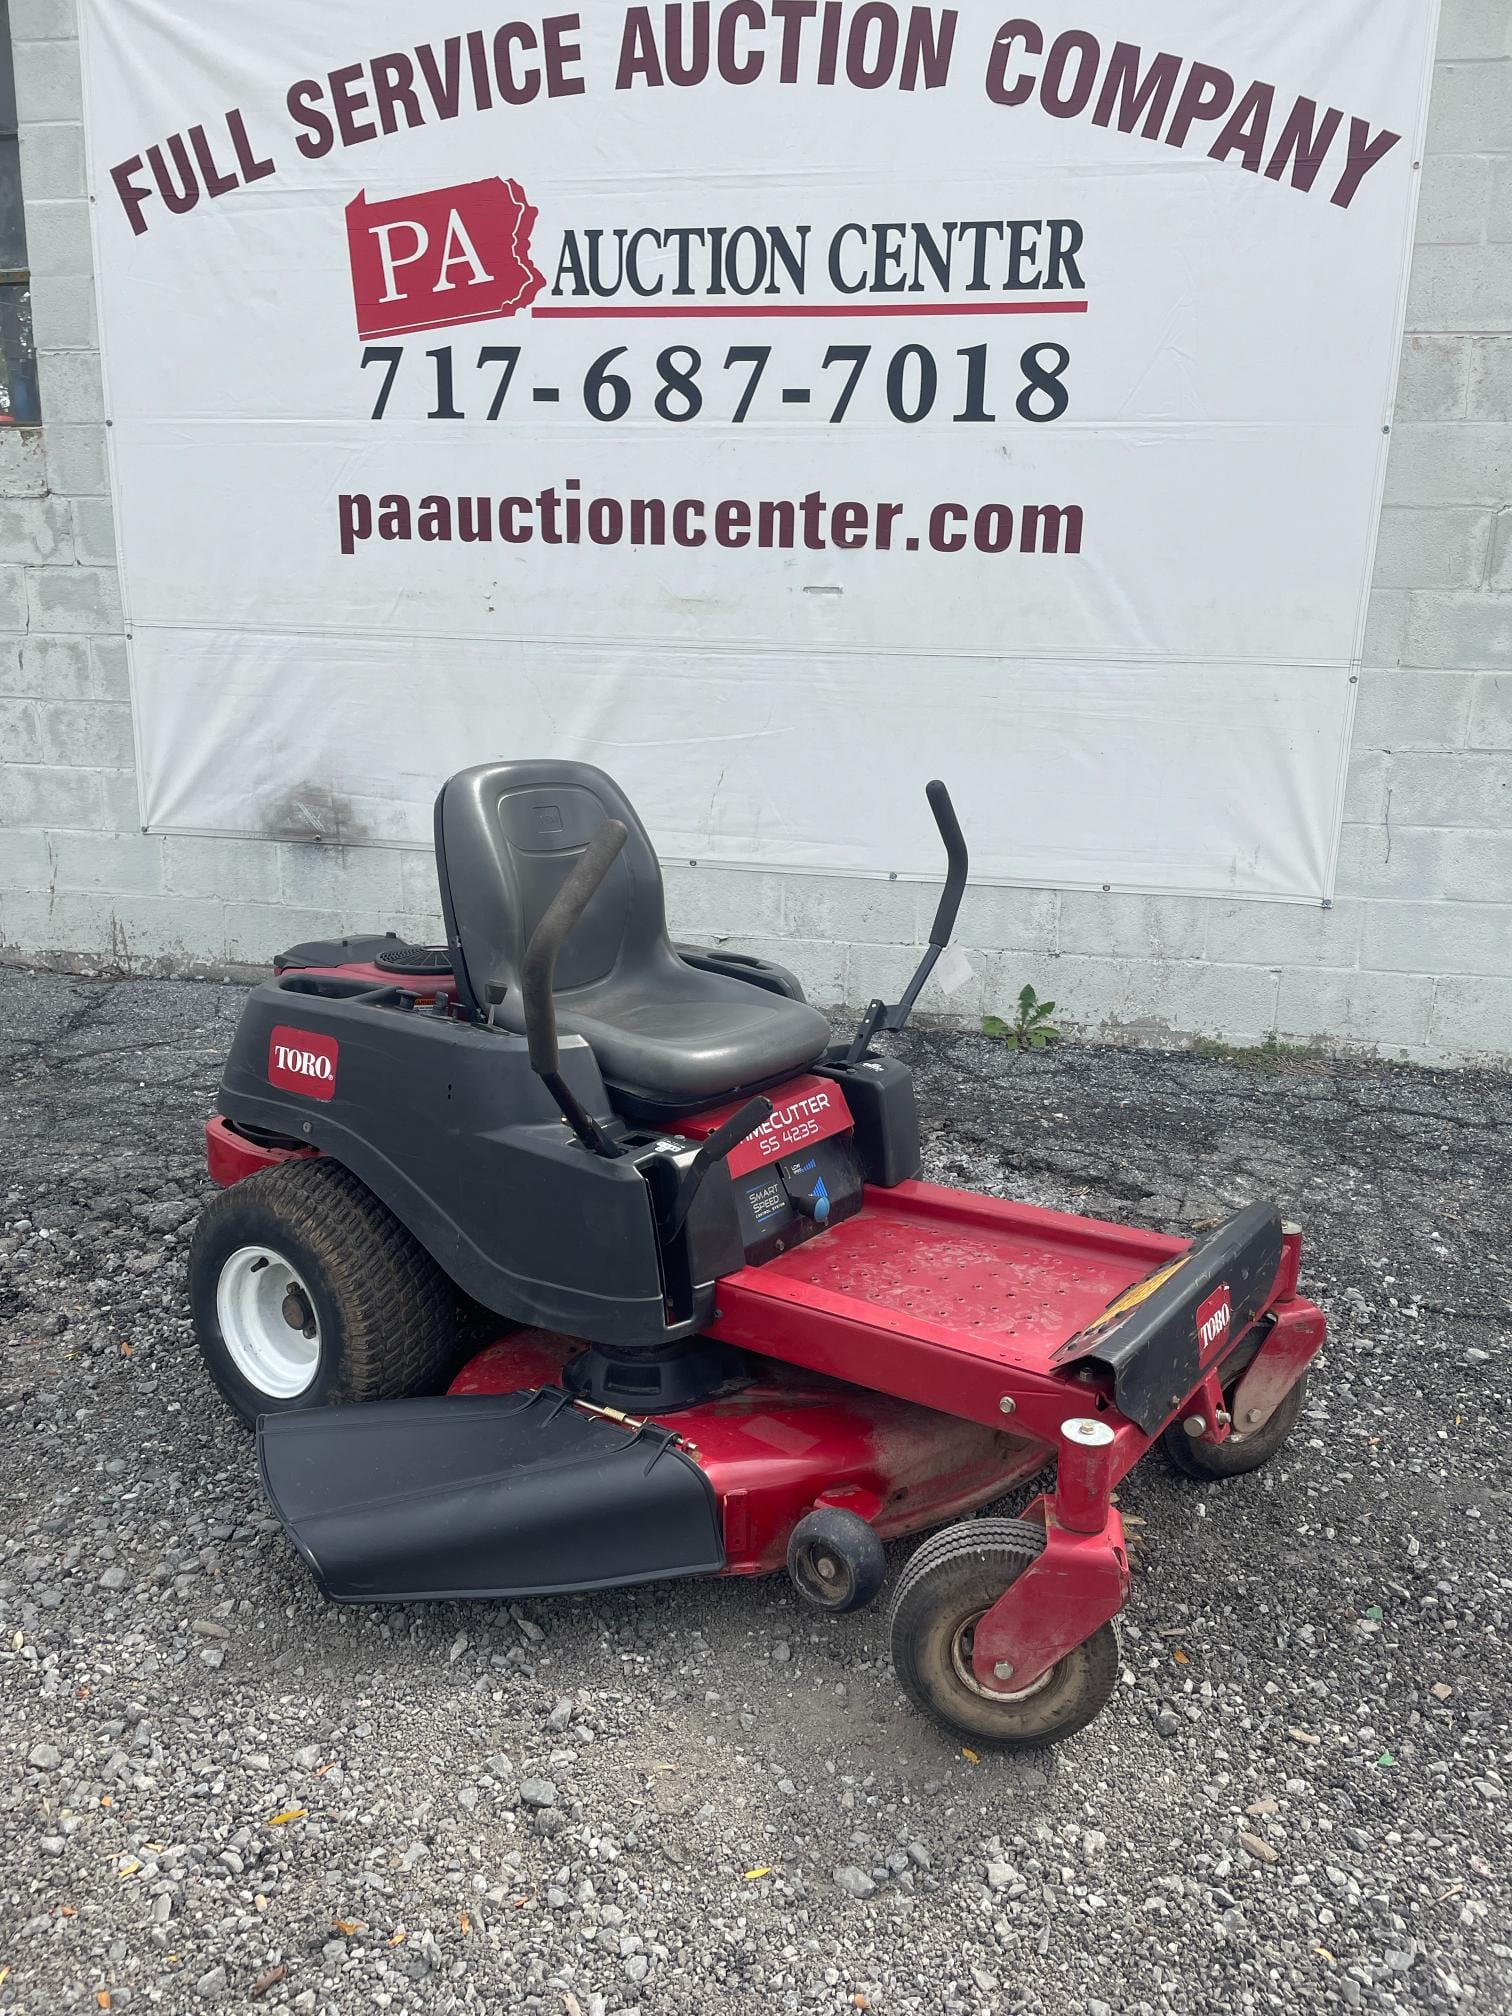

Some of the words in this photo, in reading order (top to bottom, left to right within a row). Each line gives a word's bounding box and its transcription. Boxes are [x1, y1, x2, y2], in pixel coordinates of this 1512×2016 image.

[109, 108, 276, 236] FULL
[286, 12, 586, 160] SERVICE
[615, 0, 959, 92] AUCTION
[985, 18, 1402, 209] COMPANY
[367, 207, 495, 304] PA
[551, 225, 812, 298] AUCTION
[828, 218, 1086, 294] CENTER
[360, 342, 1070, 424] 717-687-7018
[338, 478, 1084, 555] paauctioncenter.com
[274, 1044, 332, 1079] TORO
[782, 1119, 819, 1143] 4235
[749, 1183, 778, 1204] SMART
[752, 1194, 780, 1214] SPEED
[1200, 1303, 1231, 1350] TORO
